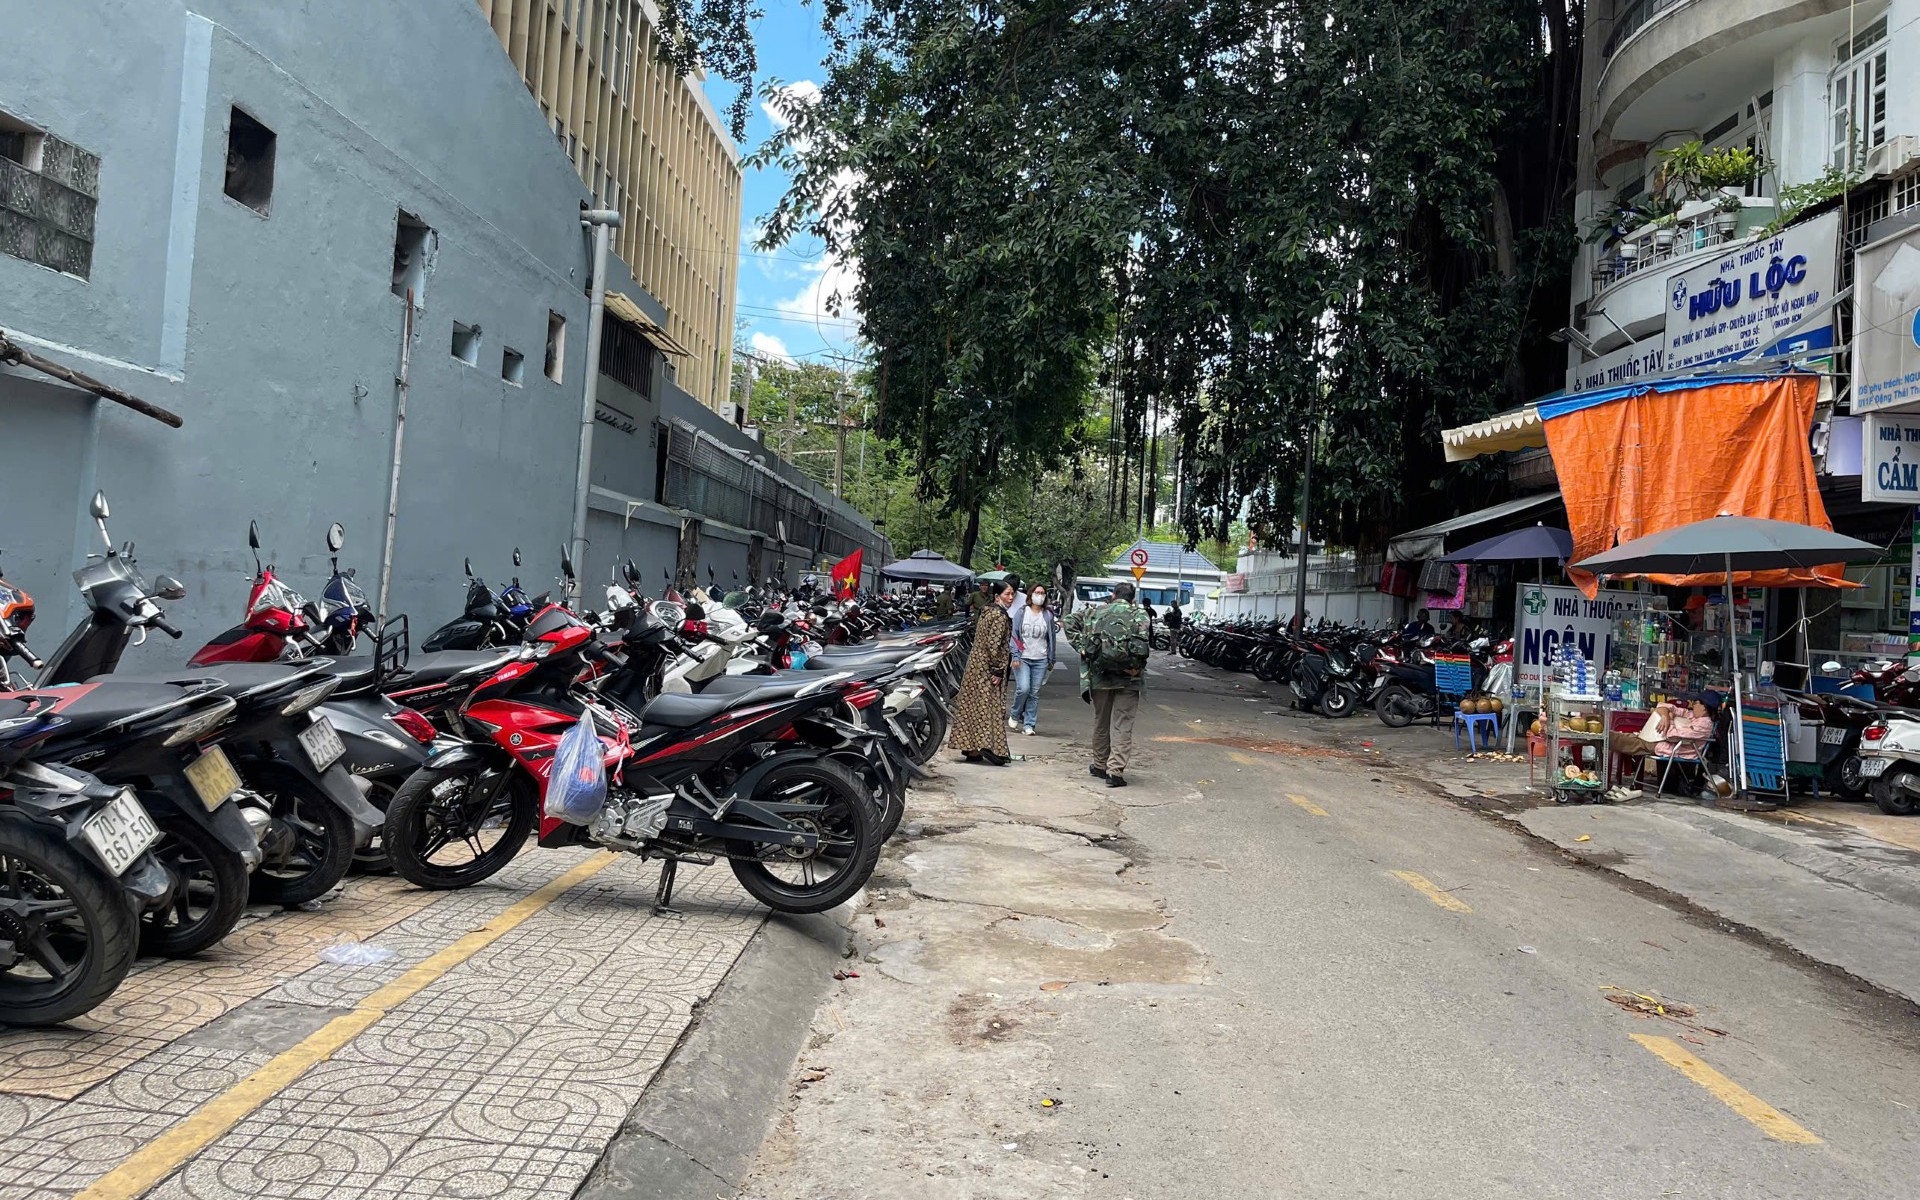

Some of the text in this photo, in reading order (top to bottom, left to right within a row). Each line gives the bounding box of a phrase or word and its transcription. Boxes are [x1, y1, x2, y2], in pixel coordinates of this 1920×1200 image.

[1720, 239, 1784, 274] NHÀ THUỐC TÂY
[1749, 255, 1807, 299] LỘC
[1585, 369, 1604, 389] NHÀ
[1608, 354, 1640, 383] THUỐC
[1643, 349, 1663, 374] TÂY
[1880, 424, 1901, 441] NHÀ
[1878, 446, 1918, 491] CẨM
[1554, 595, 1579, 617] NHÀ
[1523, 624, 1596, 667] NGÂN
[93, 797, 134, 843] 70-K1
[105, 815, 153, 869] 367.50
